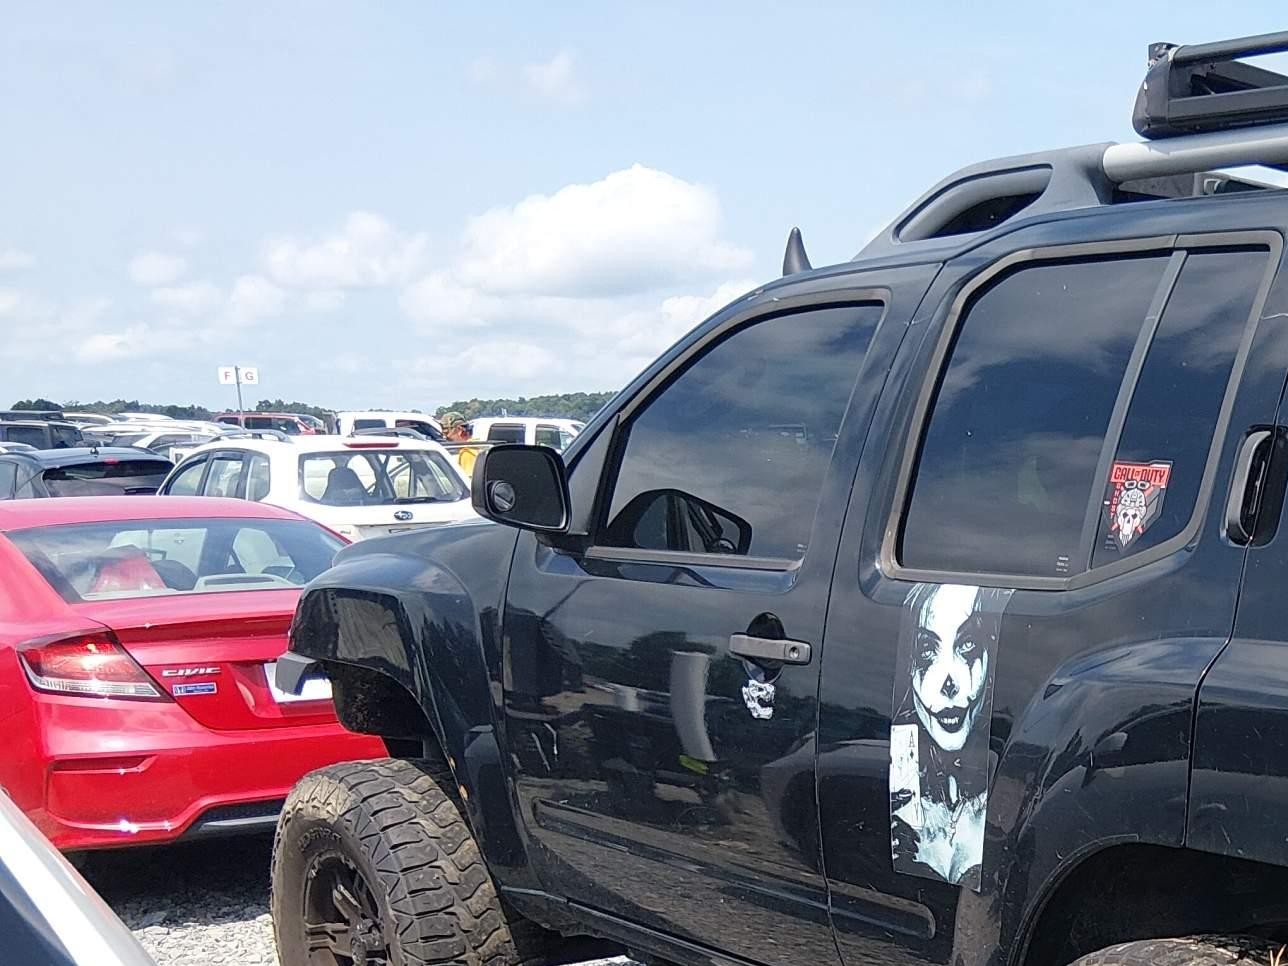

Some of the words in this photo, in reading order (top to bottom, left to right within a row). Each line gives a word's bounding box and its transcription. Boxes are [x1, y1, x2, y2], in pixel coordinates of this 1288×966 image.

[224, 371, 231, 381] F
[245, 371, 254, 381] G
[1114, 467, 1134, 480] CALL
[1141, 467, 1166, 482] DUTY
[162, 667, 221, 677] CIVIC
